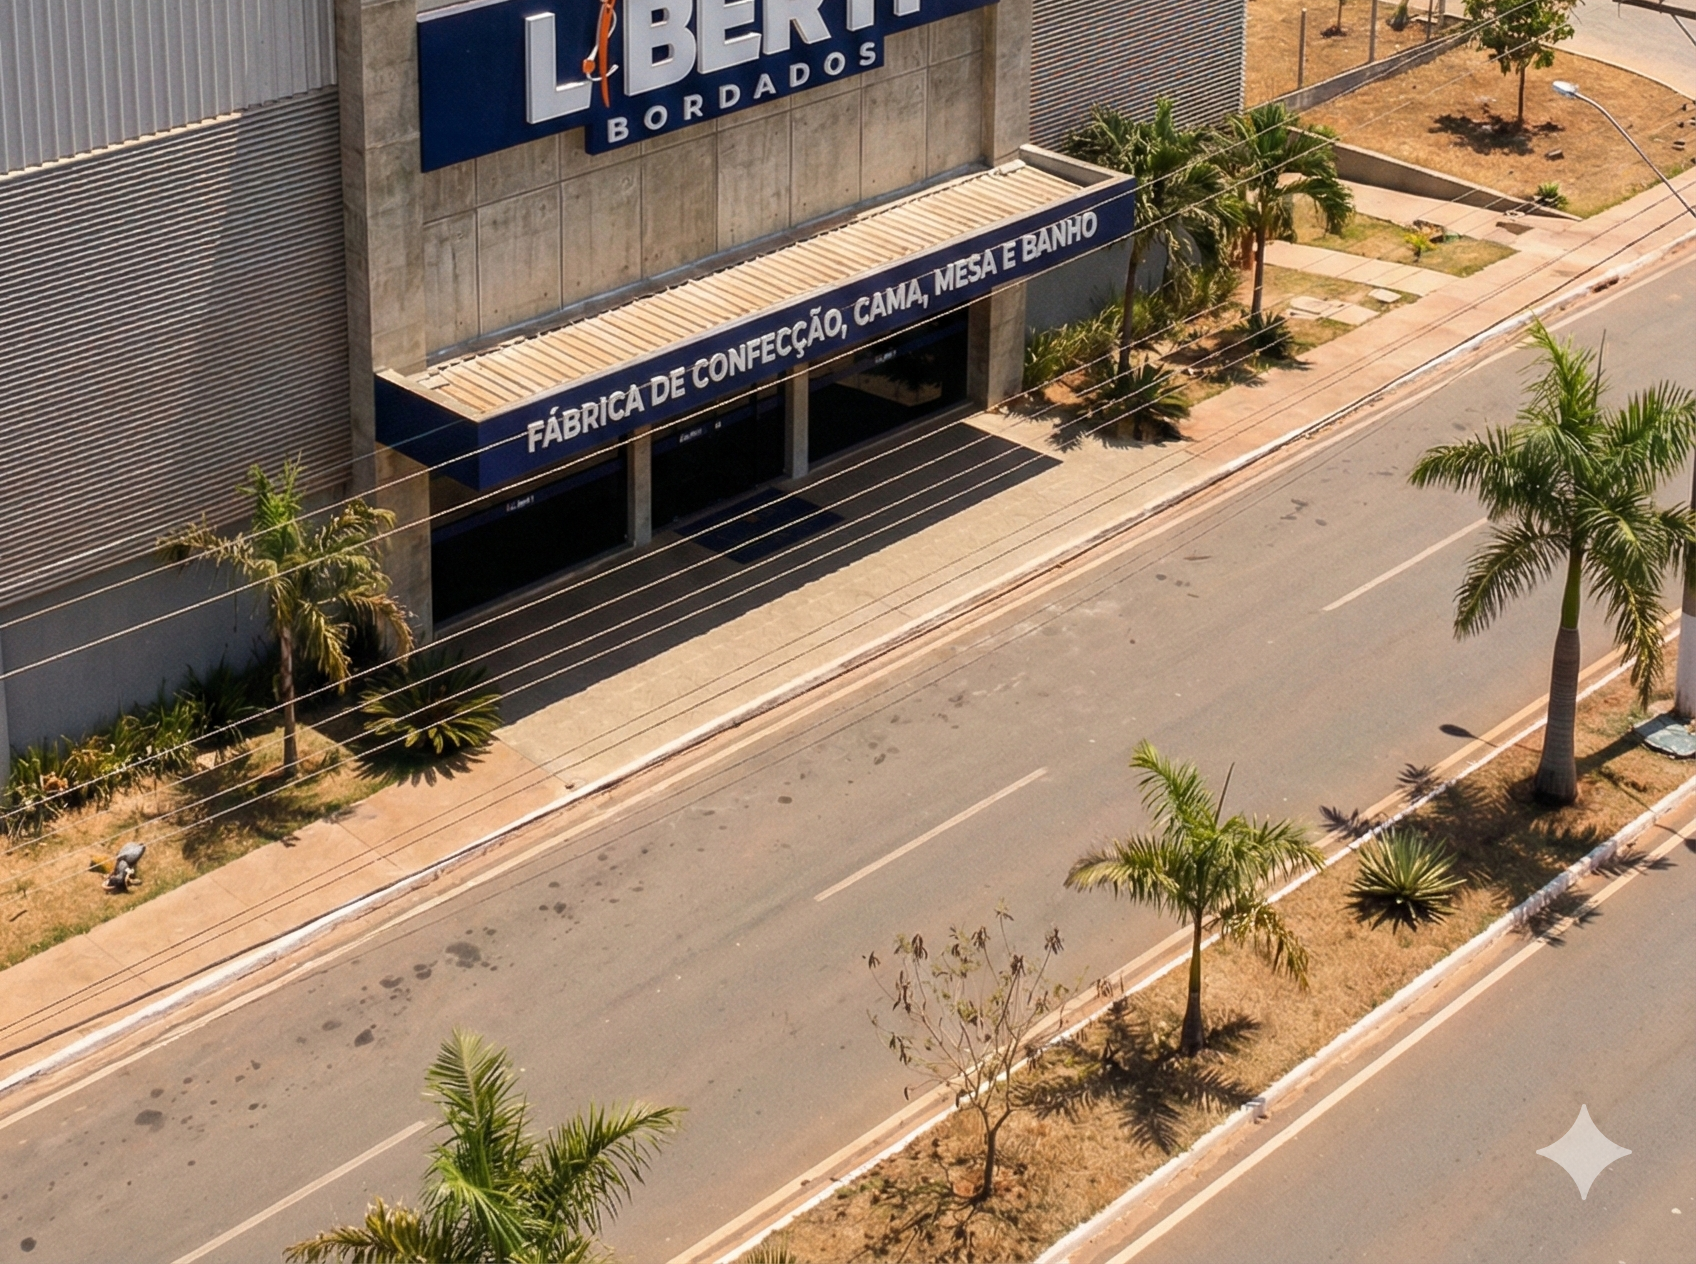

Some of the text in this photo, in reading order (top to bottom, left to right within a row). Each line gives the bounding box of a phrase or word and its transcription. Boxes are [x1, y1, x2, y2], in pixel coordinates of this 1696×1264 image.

[607, 41, 877, 143] BORDADOS
[527, 211, 1098, 453] FÁBRICA DE CONFECÇÃO, CAMA, MESA E BANHO
